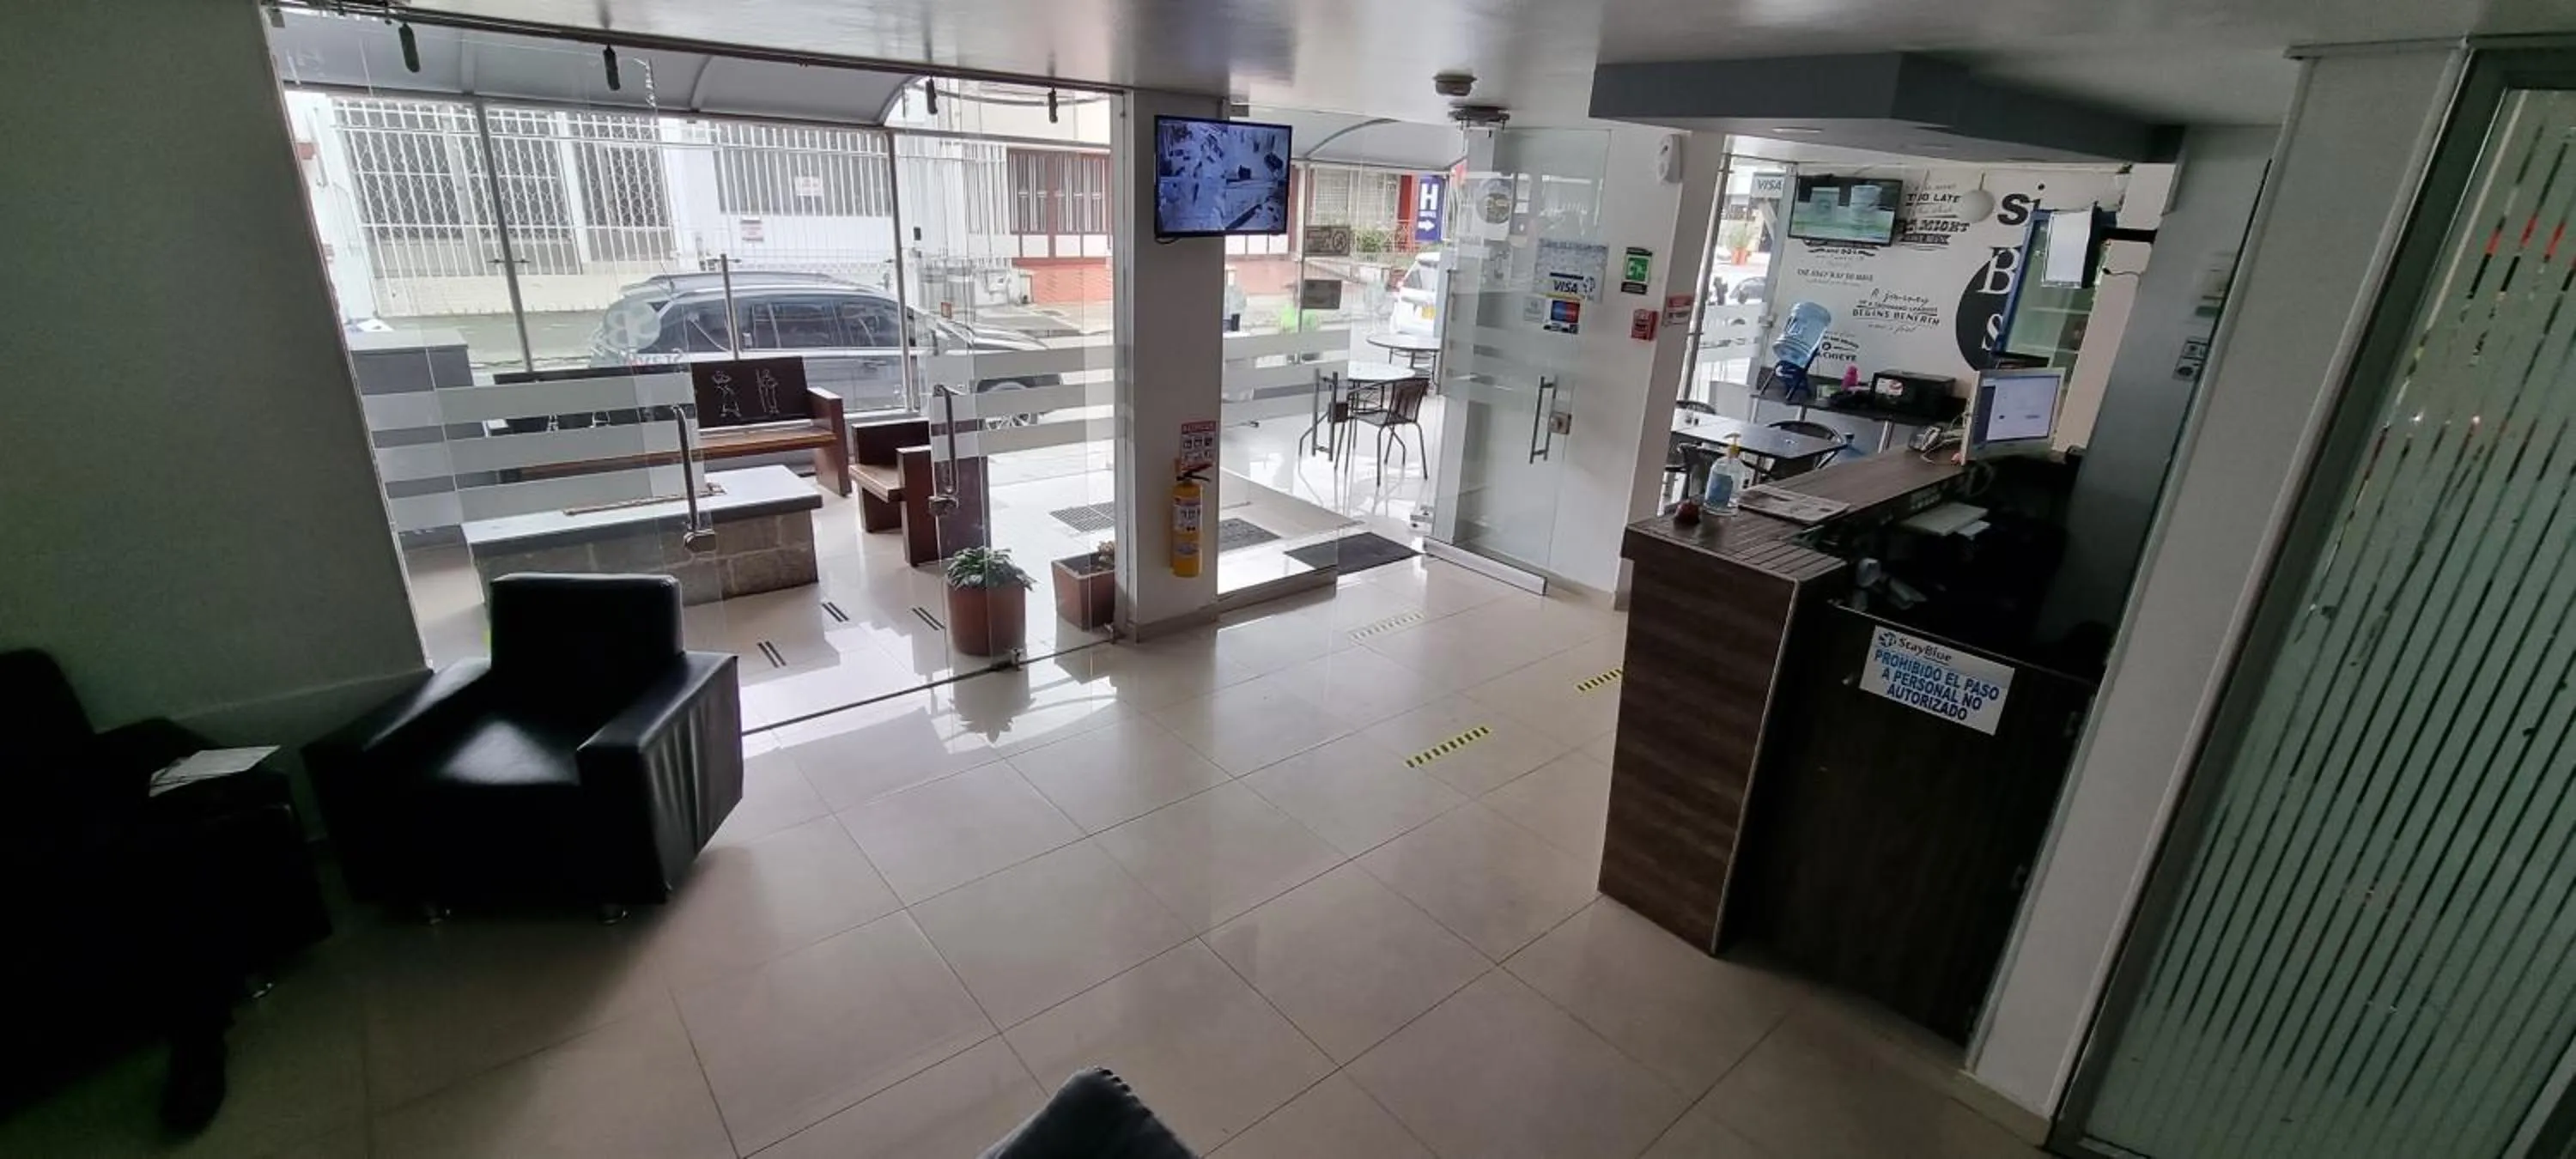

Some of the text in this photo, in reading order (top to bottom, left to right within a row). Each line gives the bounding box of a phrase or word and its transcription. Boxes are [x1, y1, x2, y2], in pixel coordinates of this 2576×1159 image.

[1419, 183, 1440, 210] H
[1552, 280, 1578, 294] VISA
[1853, 308, 1890, 319] BEGINS
[1874, 649, 2000, 701] PROHIBIDO EL PASO
[1881, 668, 1983, 711] A PERSONAL NO
[1886, 683, 1968, 720] AUTORIZADO
